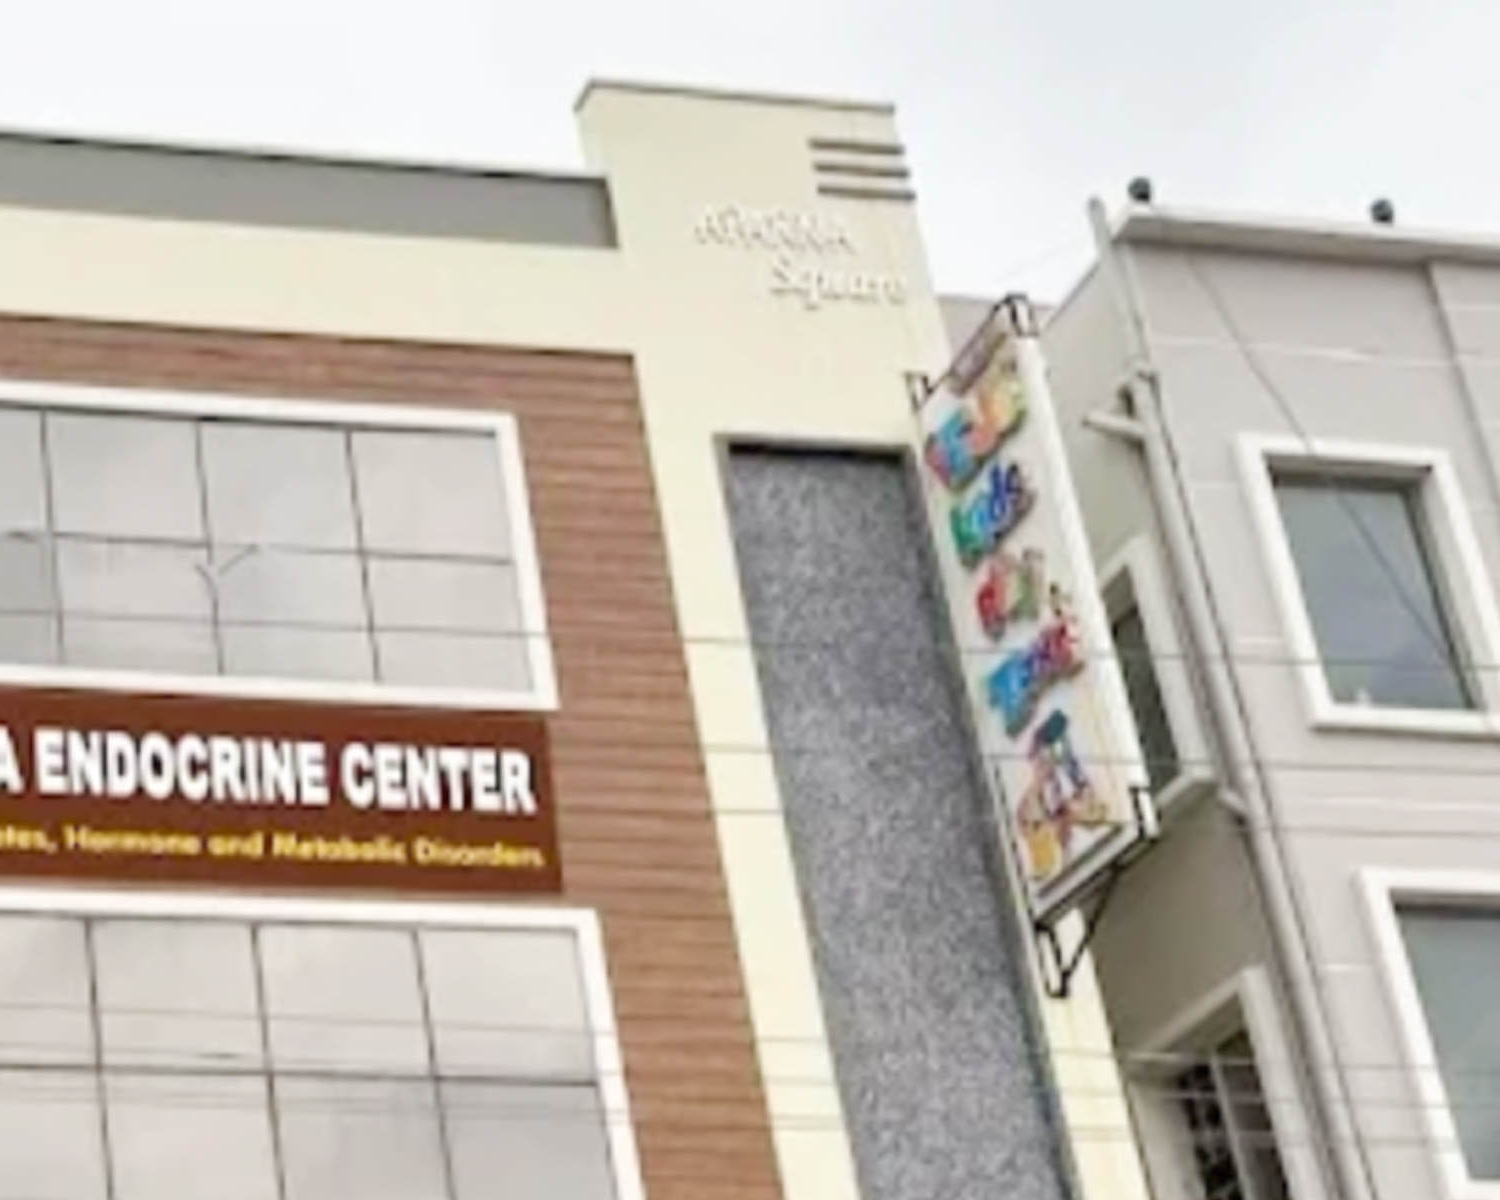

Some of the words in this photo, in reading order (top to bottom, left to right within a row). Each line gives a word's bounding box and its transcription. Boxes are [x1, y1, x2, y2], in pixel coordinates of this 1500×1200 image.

[34, 728, 330, 807] ENDOCRINE
[340, 741, 538, 815] CENTER
[208, 830, 264, 859] and
[272, 832, 407, 864] Metabolic
[414, 837, 545, 868] Disorders
